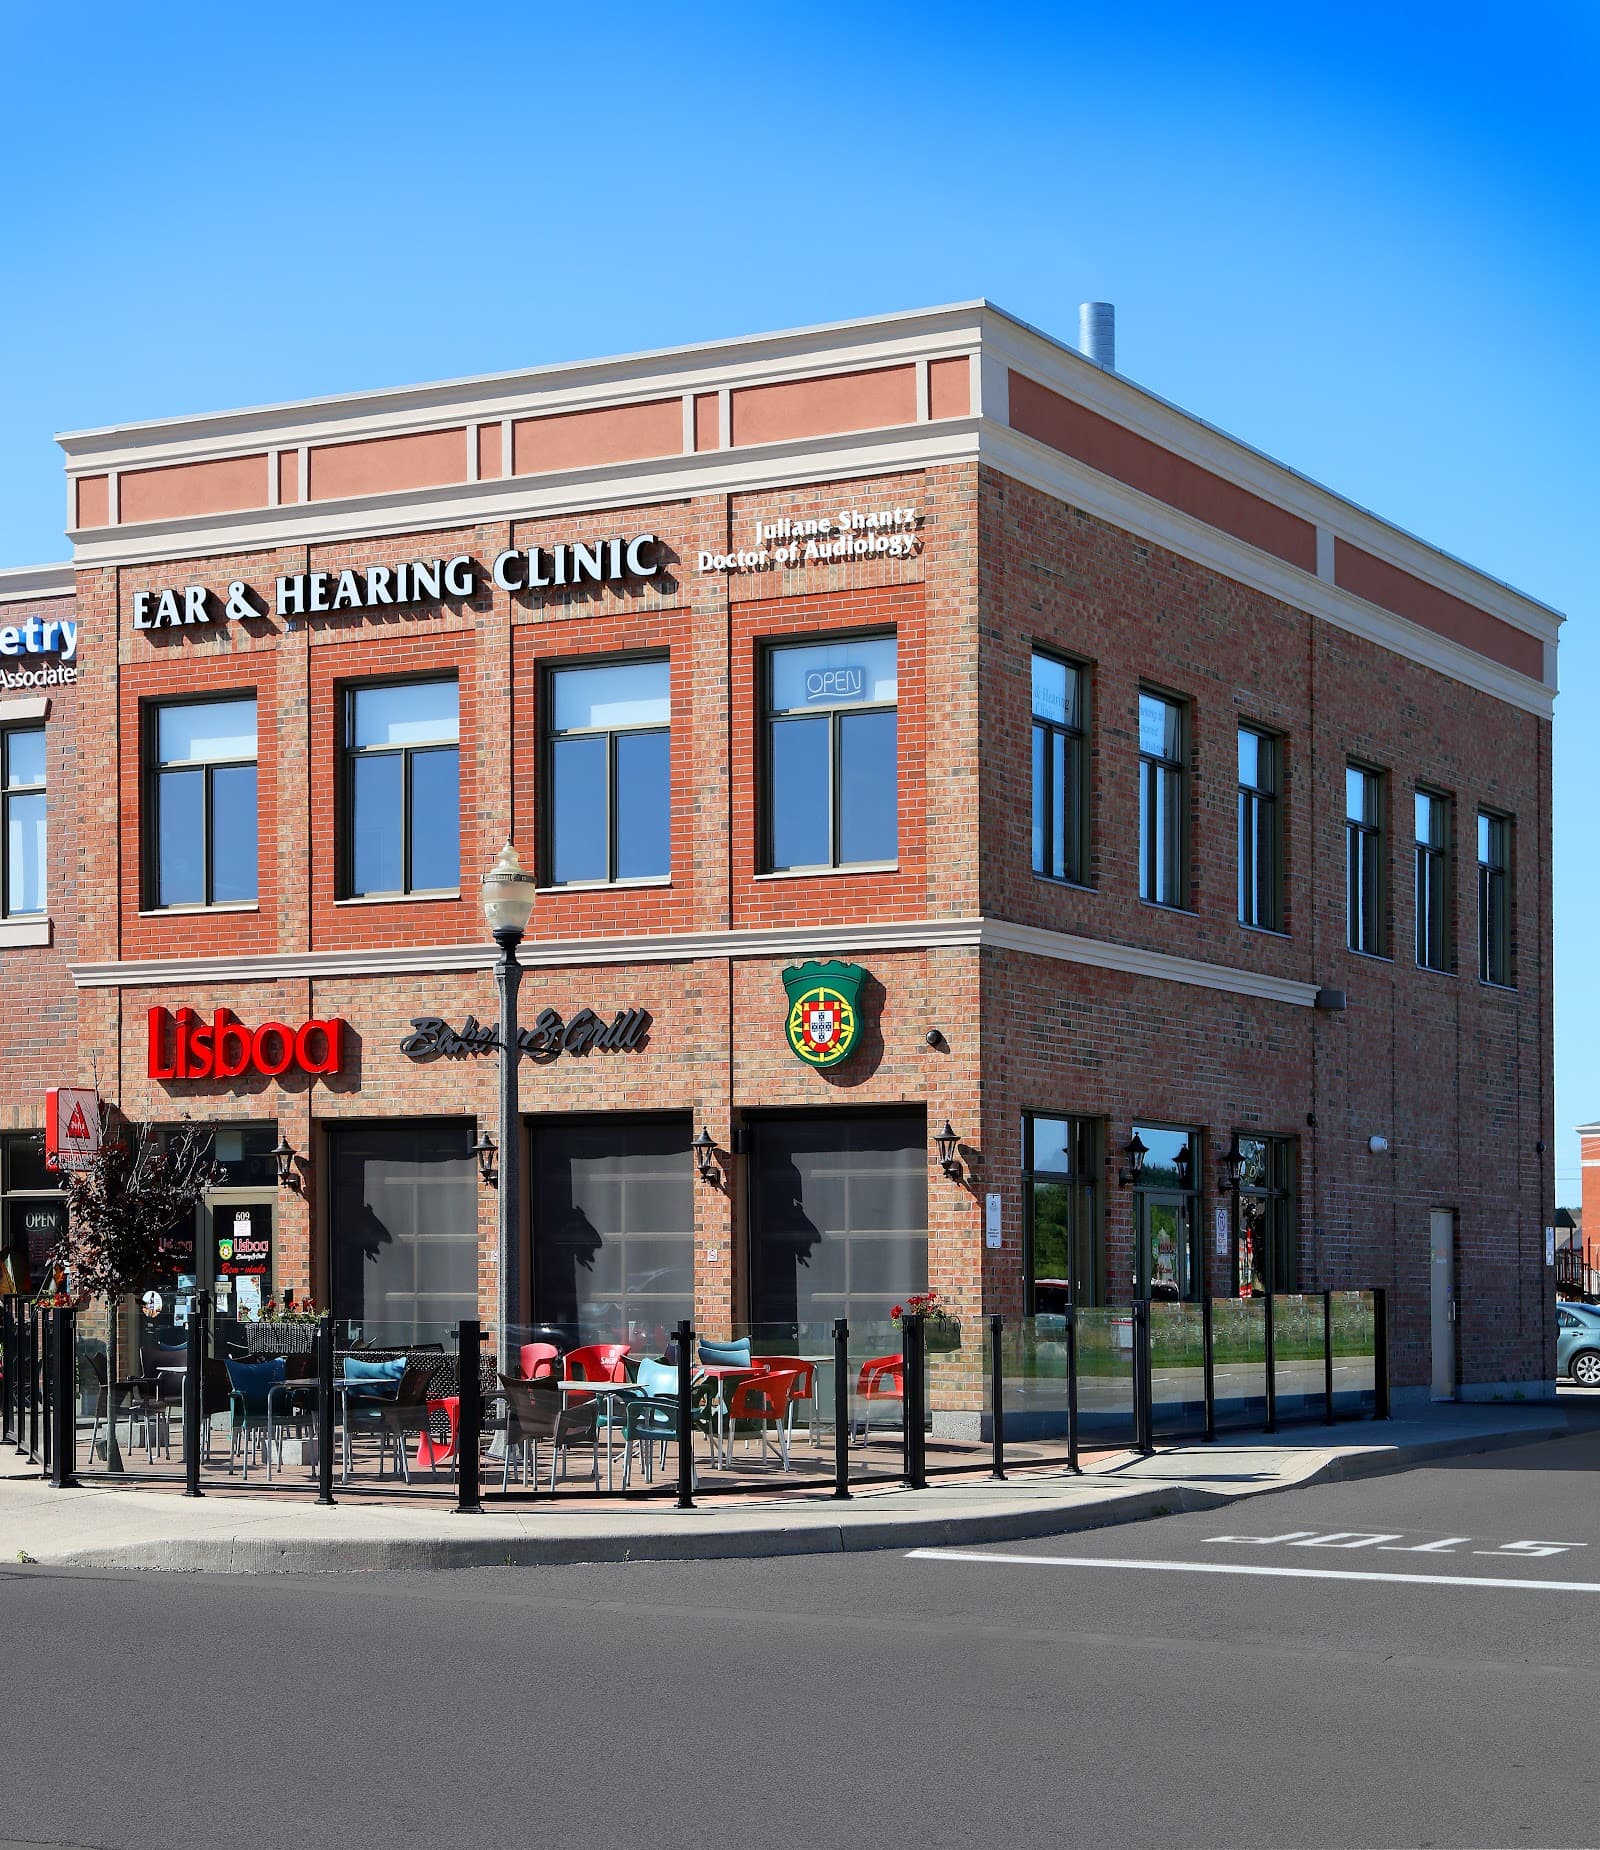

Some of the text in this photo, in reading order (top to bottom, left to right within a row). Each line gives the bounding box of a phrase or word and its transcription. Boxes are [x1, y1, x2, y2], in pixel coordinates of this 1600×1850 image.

[755, 507, 916, 546] Juliane Shantz
[697, 531, 915, 572] Doctor of Audiology
[133, 534, 658, 630] EAR & HEARING CLINIC
[807, 670, 862, 693] OPEN
[147, 1006, 344, 1079] Lisboa
[522, 1008, 568, 1057] &
[561, 1008, 650, 1051] Grill
[25, 1211, 56, 1228] OPEN
[235, 1211, 250, 1221] 609
[233, 1238, 269, 1252] Lisboa
[1200, 1531, 1588, 1558] STOP
